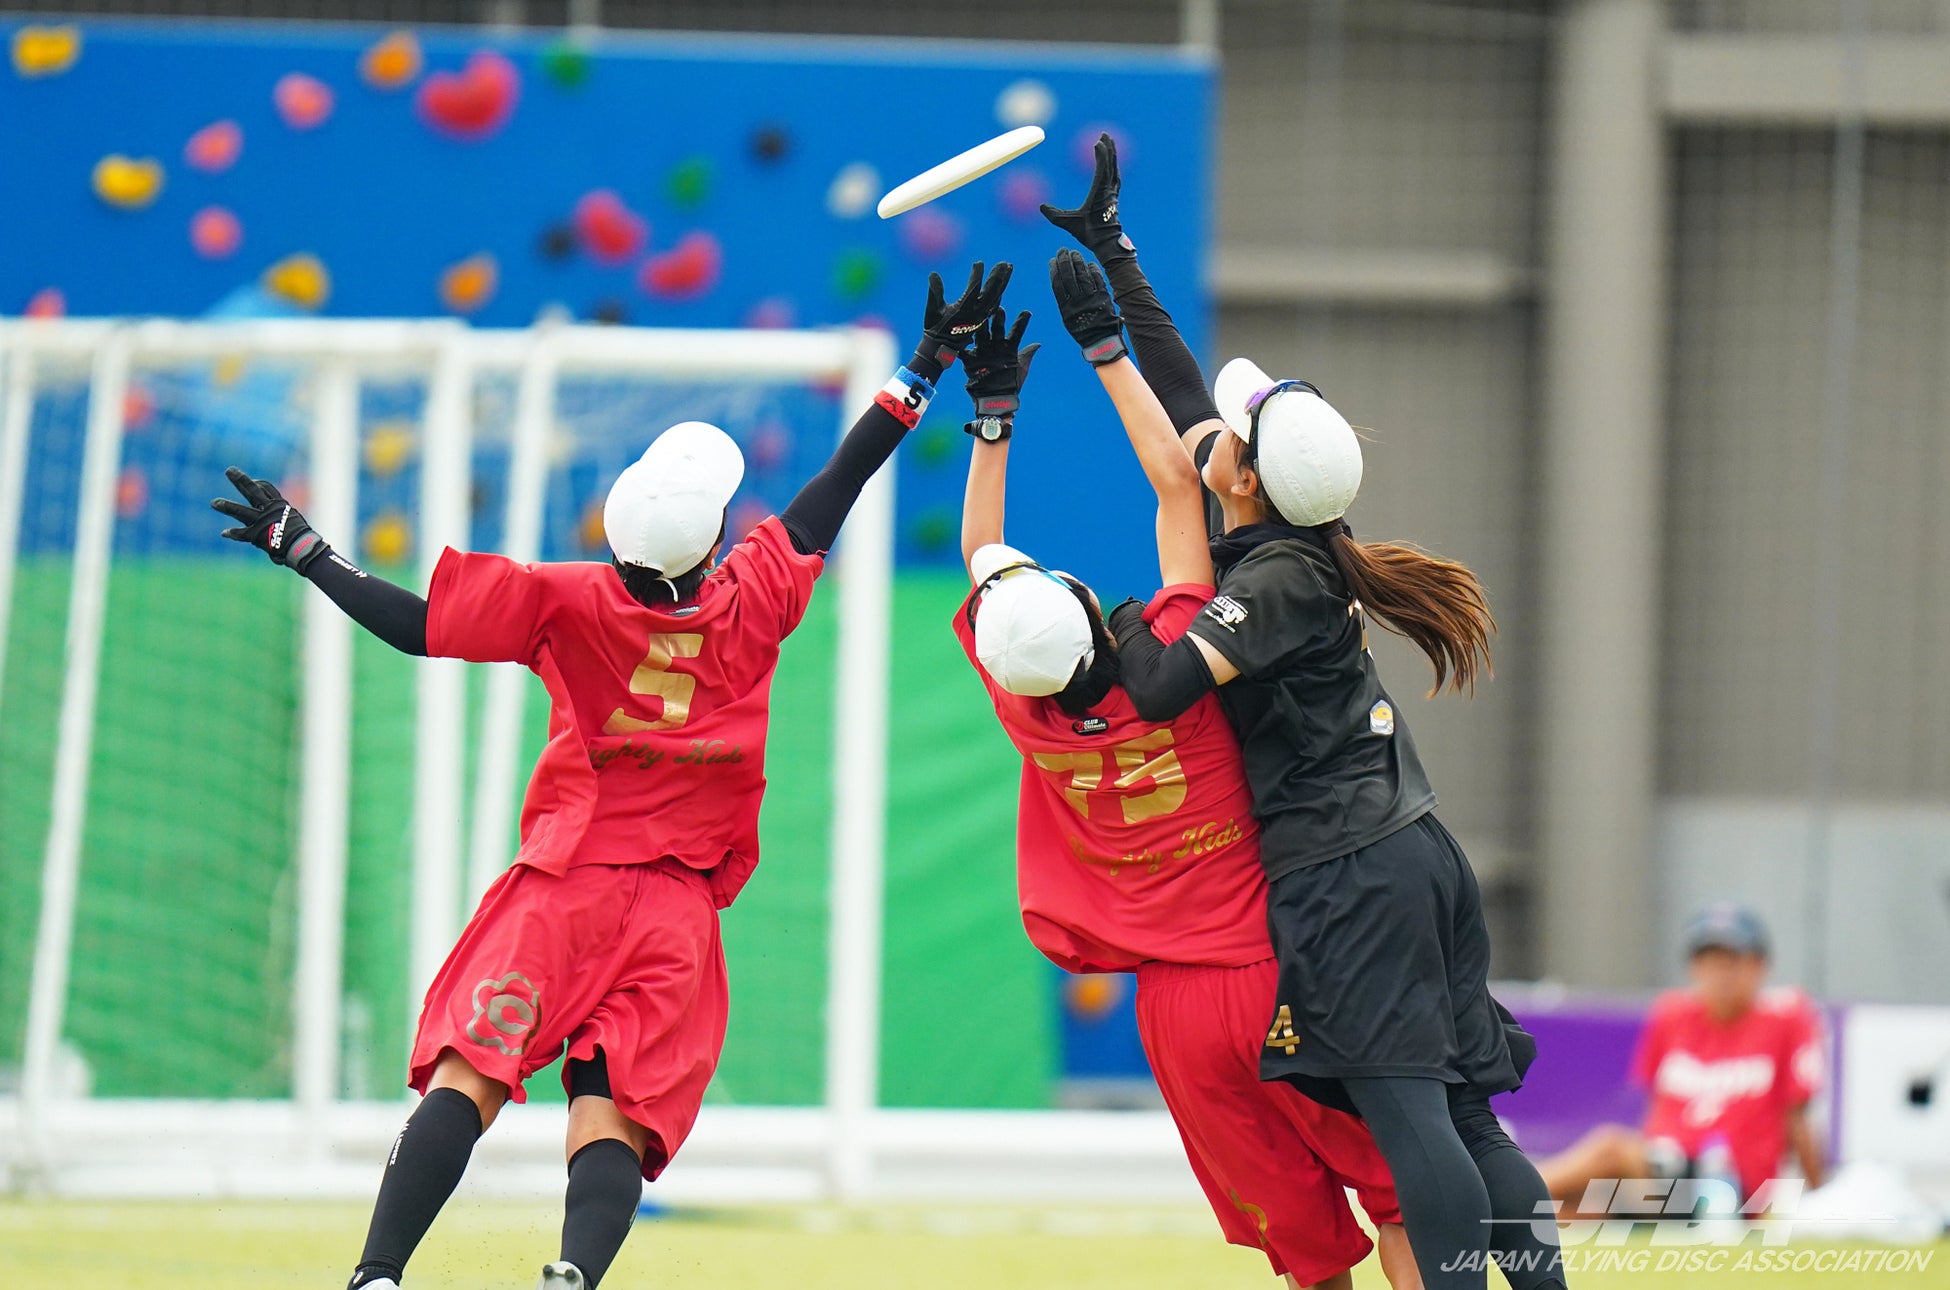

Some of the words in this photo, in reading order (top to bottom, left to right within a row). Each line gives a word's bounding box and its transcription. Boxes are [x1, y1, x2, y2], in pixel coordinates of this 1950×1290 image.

[903, 380, 927, 411] 5
[601, 632, 705, 737] 5
[672, 738, 744, 765] Kids
[1031, 727, 1188, 825] 75
[1172, 817, 1243, 860] Kids
[1265, 1003, 1301, 1056] 4
